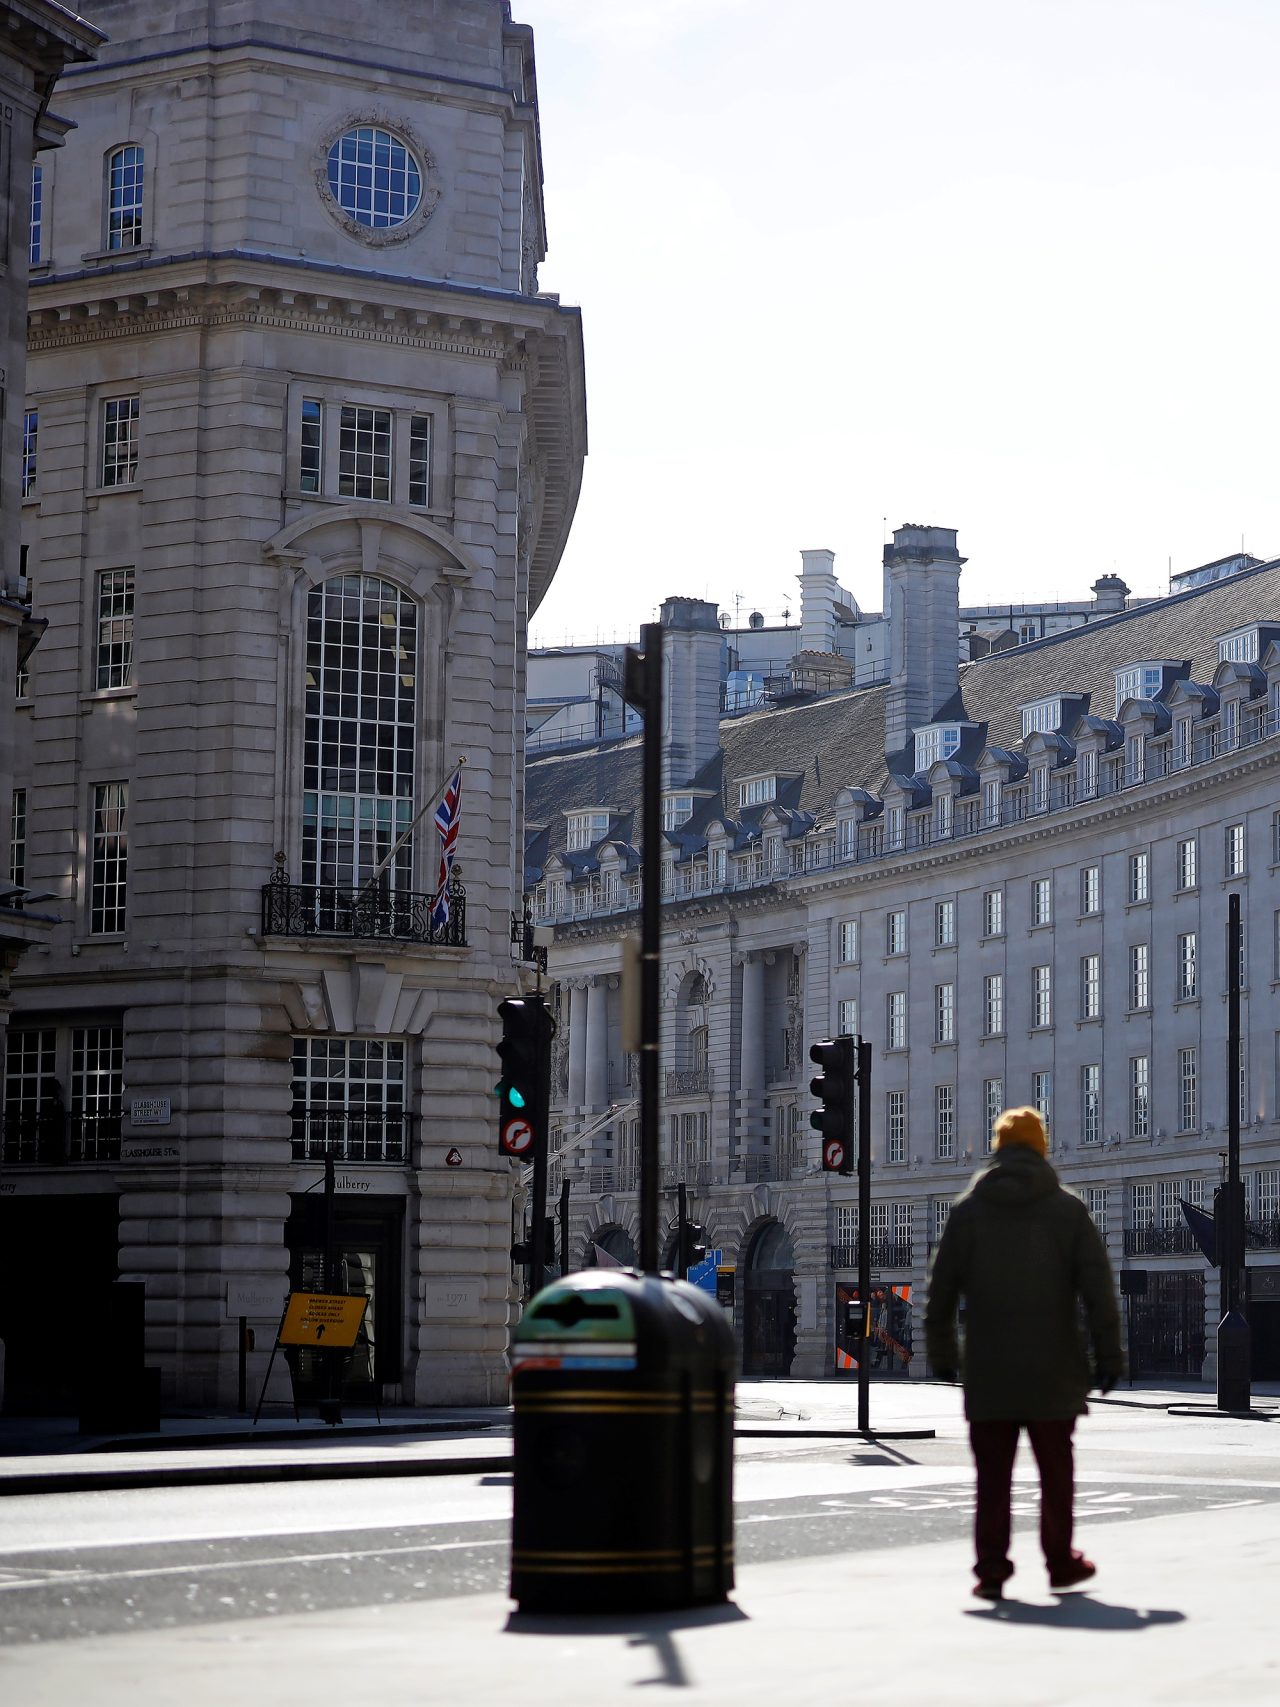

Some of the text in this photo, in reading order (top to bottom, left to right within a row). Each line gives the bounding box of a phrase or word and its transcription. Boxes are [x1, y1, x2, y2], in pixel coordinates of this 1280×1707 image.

[133, 1100, 167, 1109] GLASSHOUSE
[133, 1109, 152, 1117] STREET
[334, 1176, 371, 1191] ulberry
[237, 1289, 275, 1305] Mulberry
